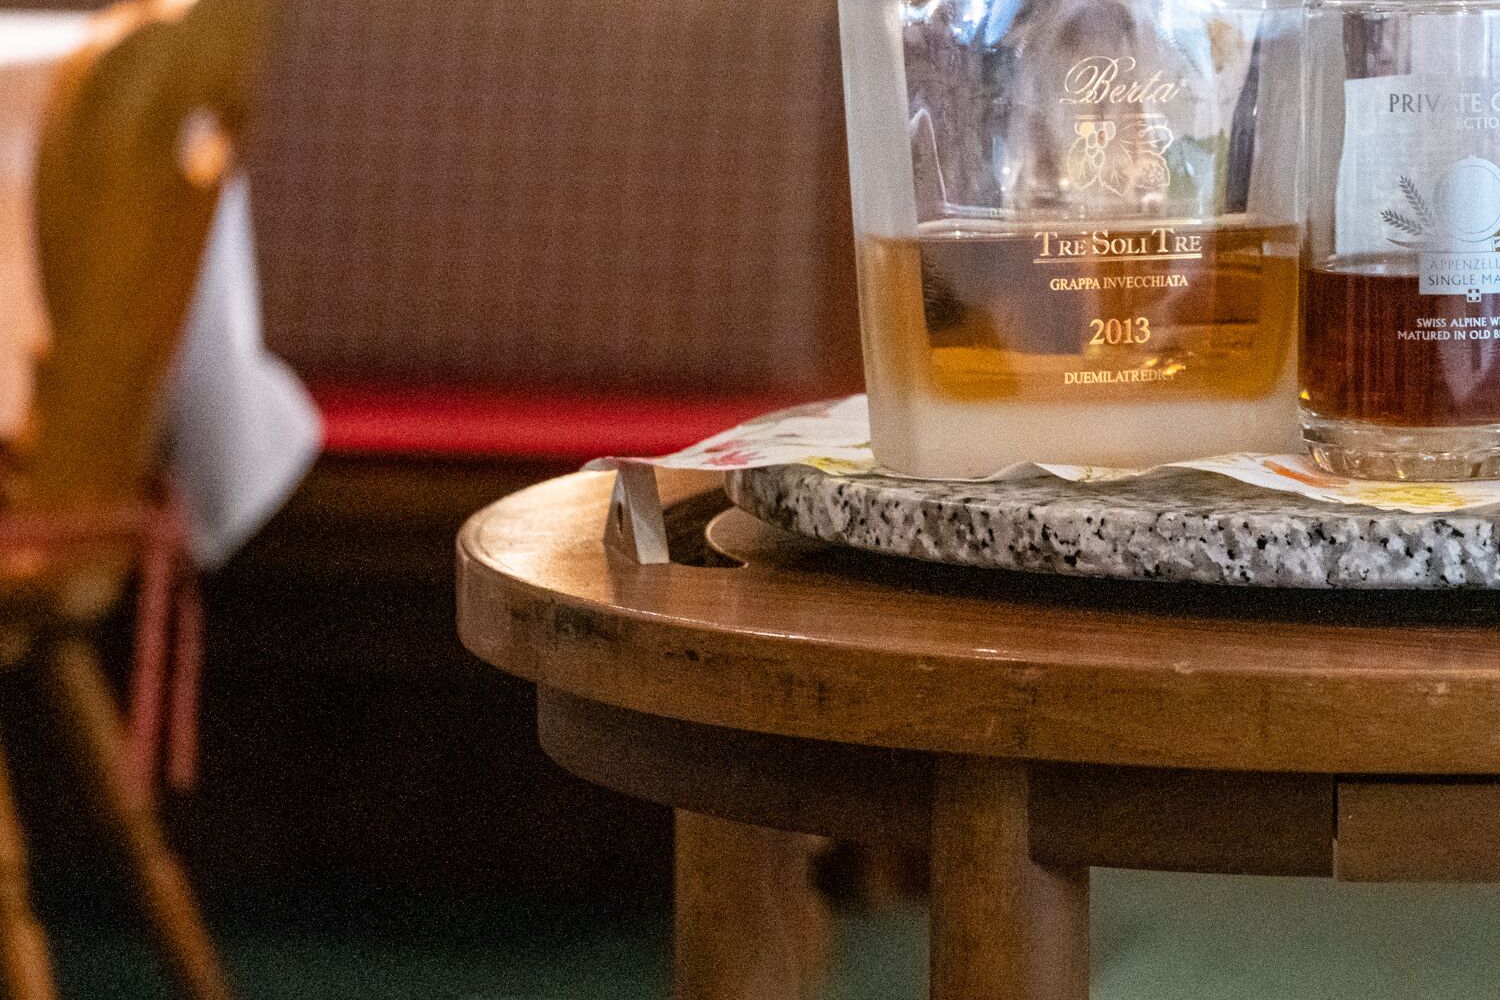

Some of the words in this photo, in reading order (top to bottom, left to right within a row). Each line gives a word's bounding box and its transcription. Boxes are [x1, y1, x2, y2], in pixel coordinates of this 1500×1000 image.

[1059, 56, 1180, 104] Berta
[1034, 231, 1088, 257] TRE
[1091, 229, 1148, 255] SOLI
[1151, 227, 1202, 254] TRE
[1050, 278, 1101, 291] GRAPPA
[1103, 275, 1189, 290] INVECCHIATA
[1428, 273, 1476, 286] SINGLE
[1416, 318, 1446, 328] SWISS
[1450, 316, 1487, 328] ALPINE
[1089, 318, 1151, 345] 2013
[1397, 329, 1451, 341] MATURED
[1454, 329, 1467, 341] IN
[1469, 328, 1491, 340] OLD
